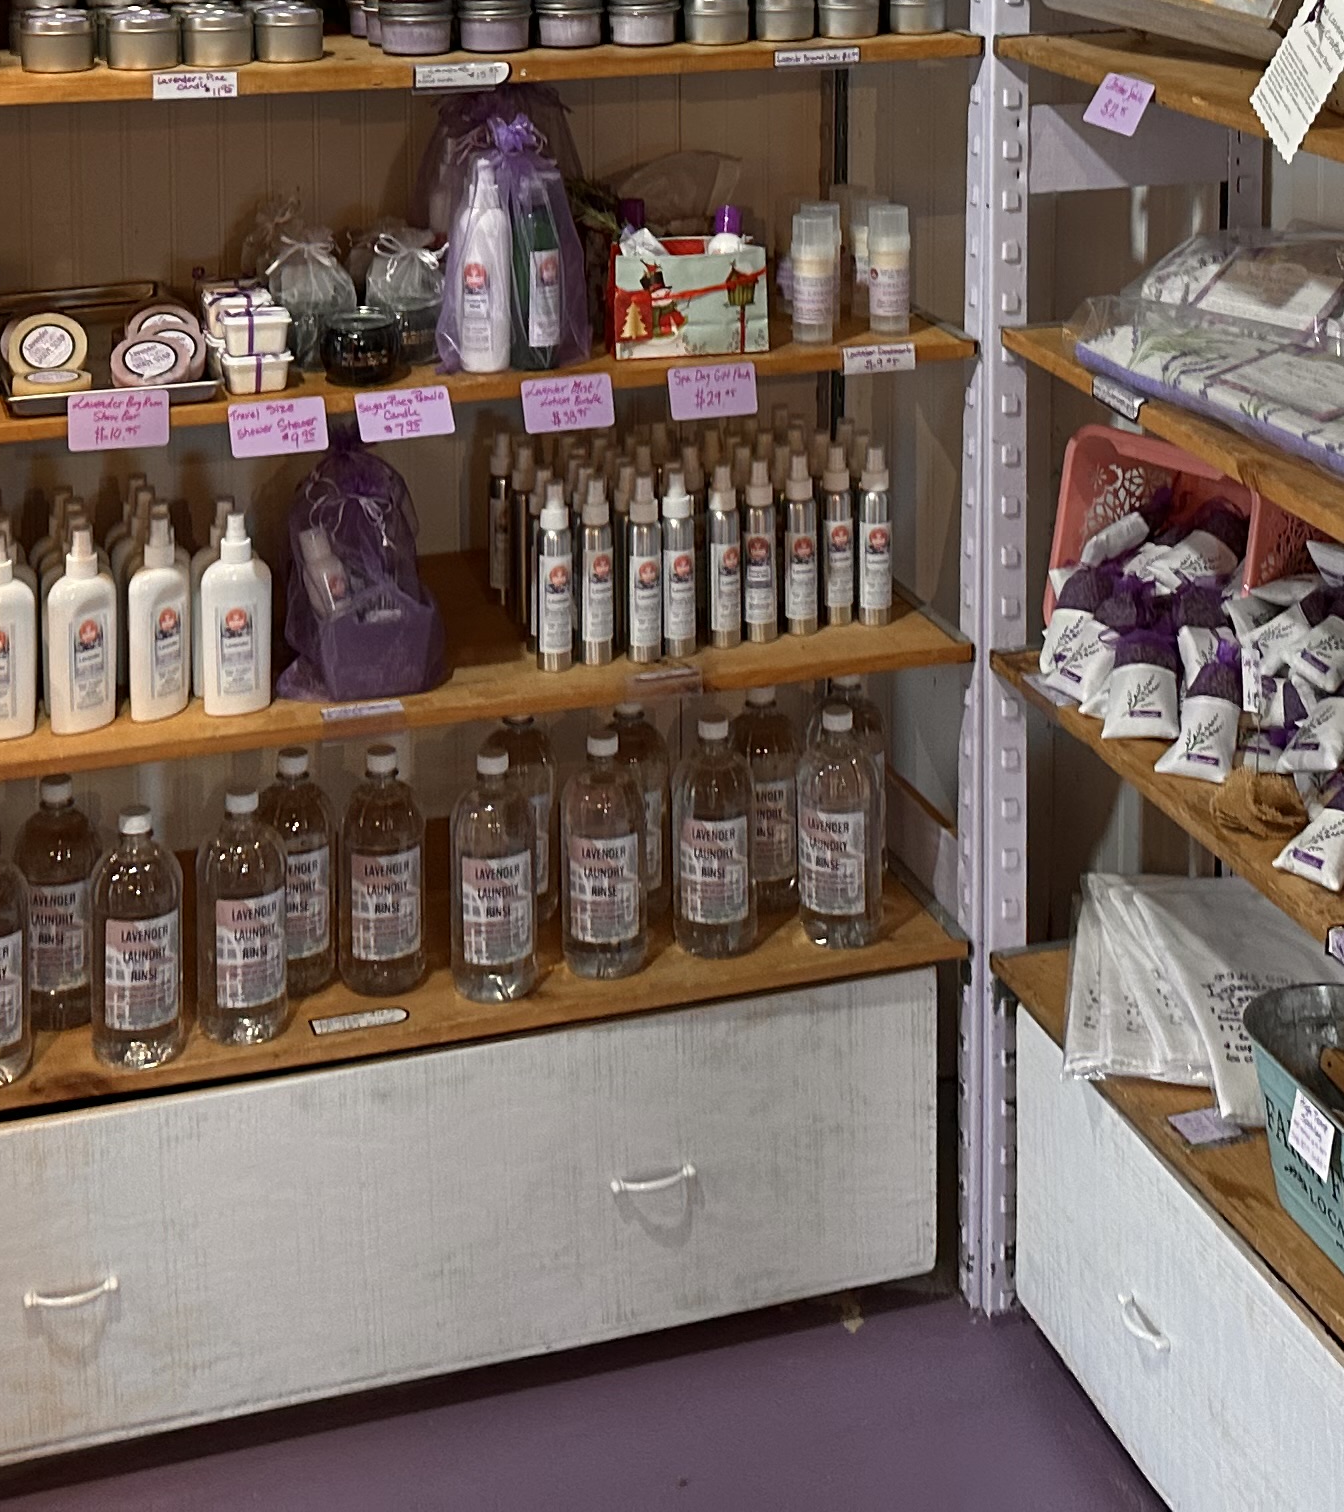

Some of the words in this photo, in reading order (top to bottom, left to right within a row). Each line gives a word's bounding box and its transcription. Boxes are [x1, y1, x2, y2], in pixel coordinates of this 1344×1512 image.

[673, 369, 691, 386] Spa
[695, 369, 711, 382] Day
[72, 395, 124, 411] Lavender
[230, 407, 260, 422] Travel
[265, 403, 295, 415] Size
[1264, 1092, 1324, 1188] FA
